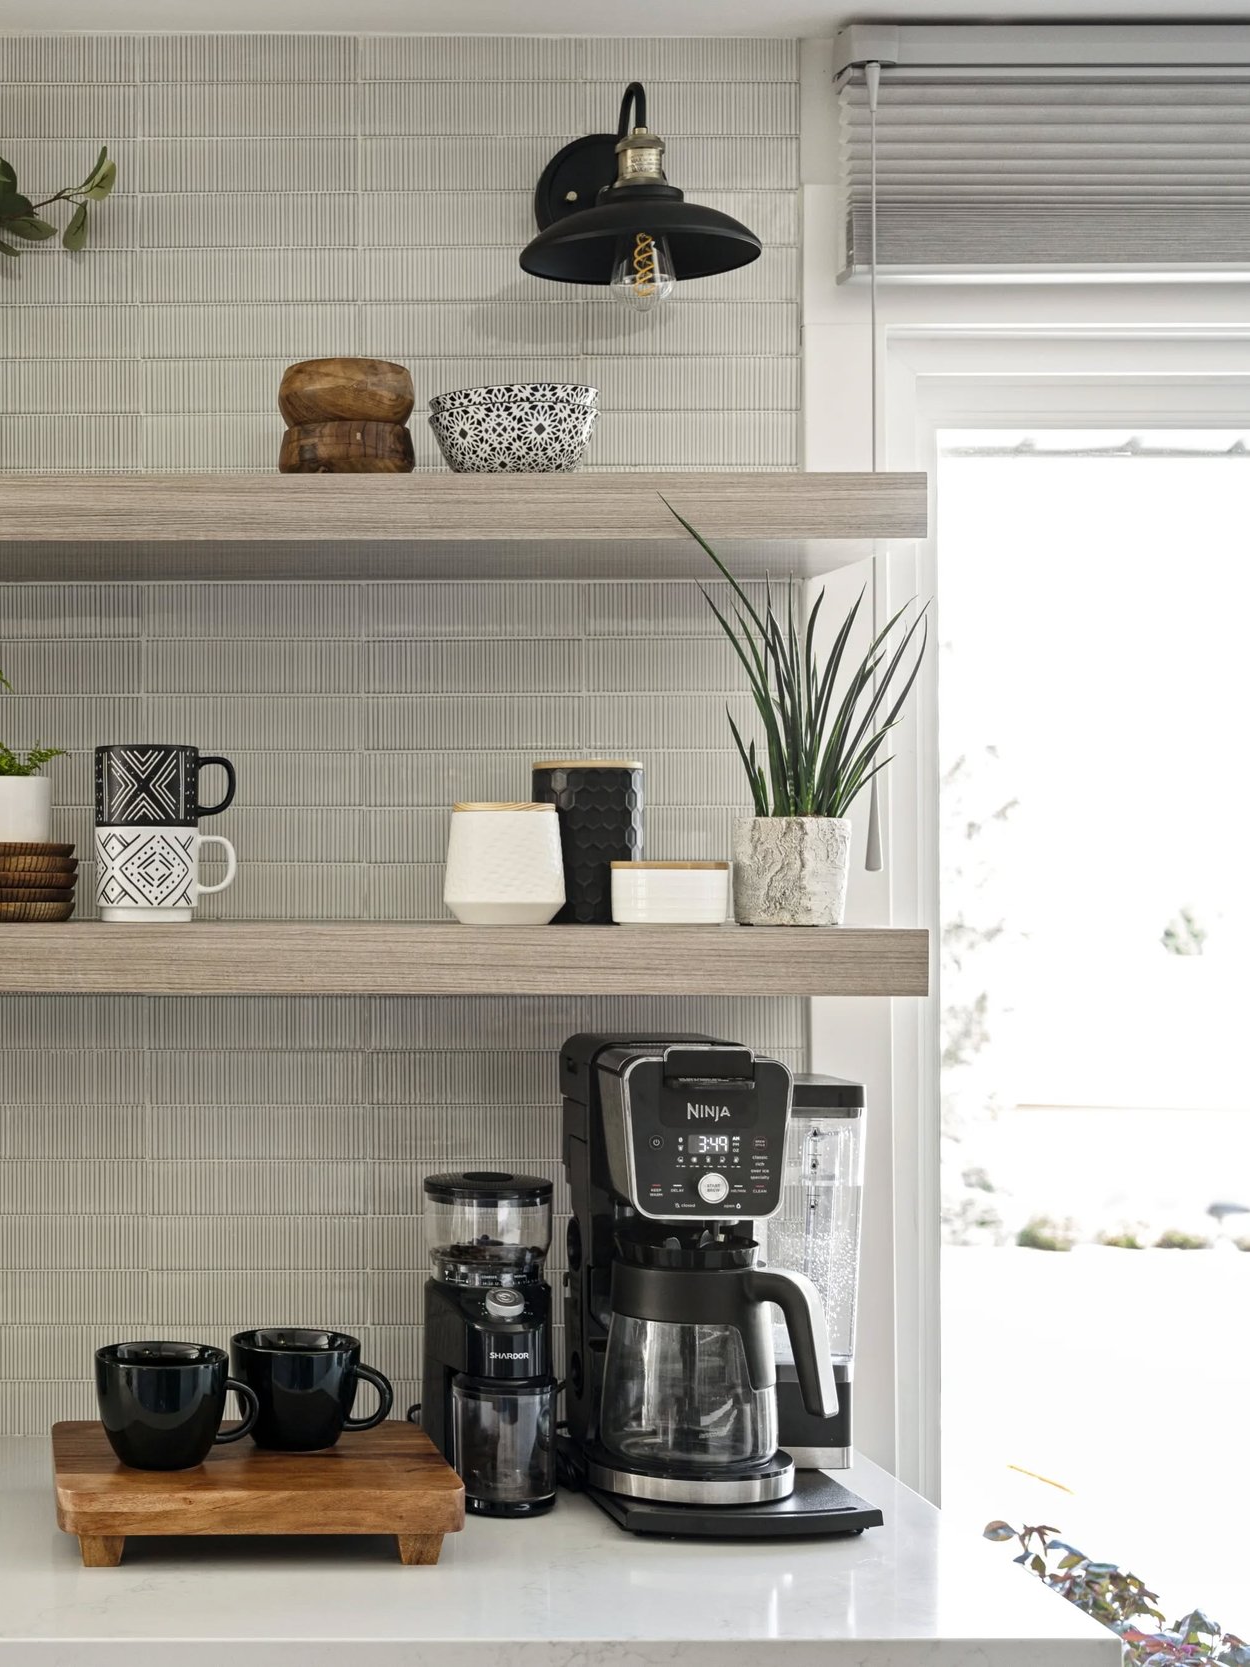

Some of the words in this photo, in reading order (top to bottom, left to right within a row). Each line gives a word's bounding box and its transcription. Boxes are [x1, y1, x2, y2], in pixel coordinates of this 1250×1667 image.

[687, 1102, 731, 1122] NINJA
[698, 1136, 728, 1153] 3:49
[489, 1351, 529, 1360] SHARDOR
